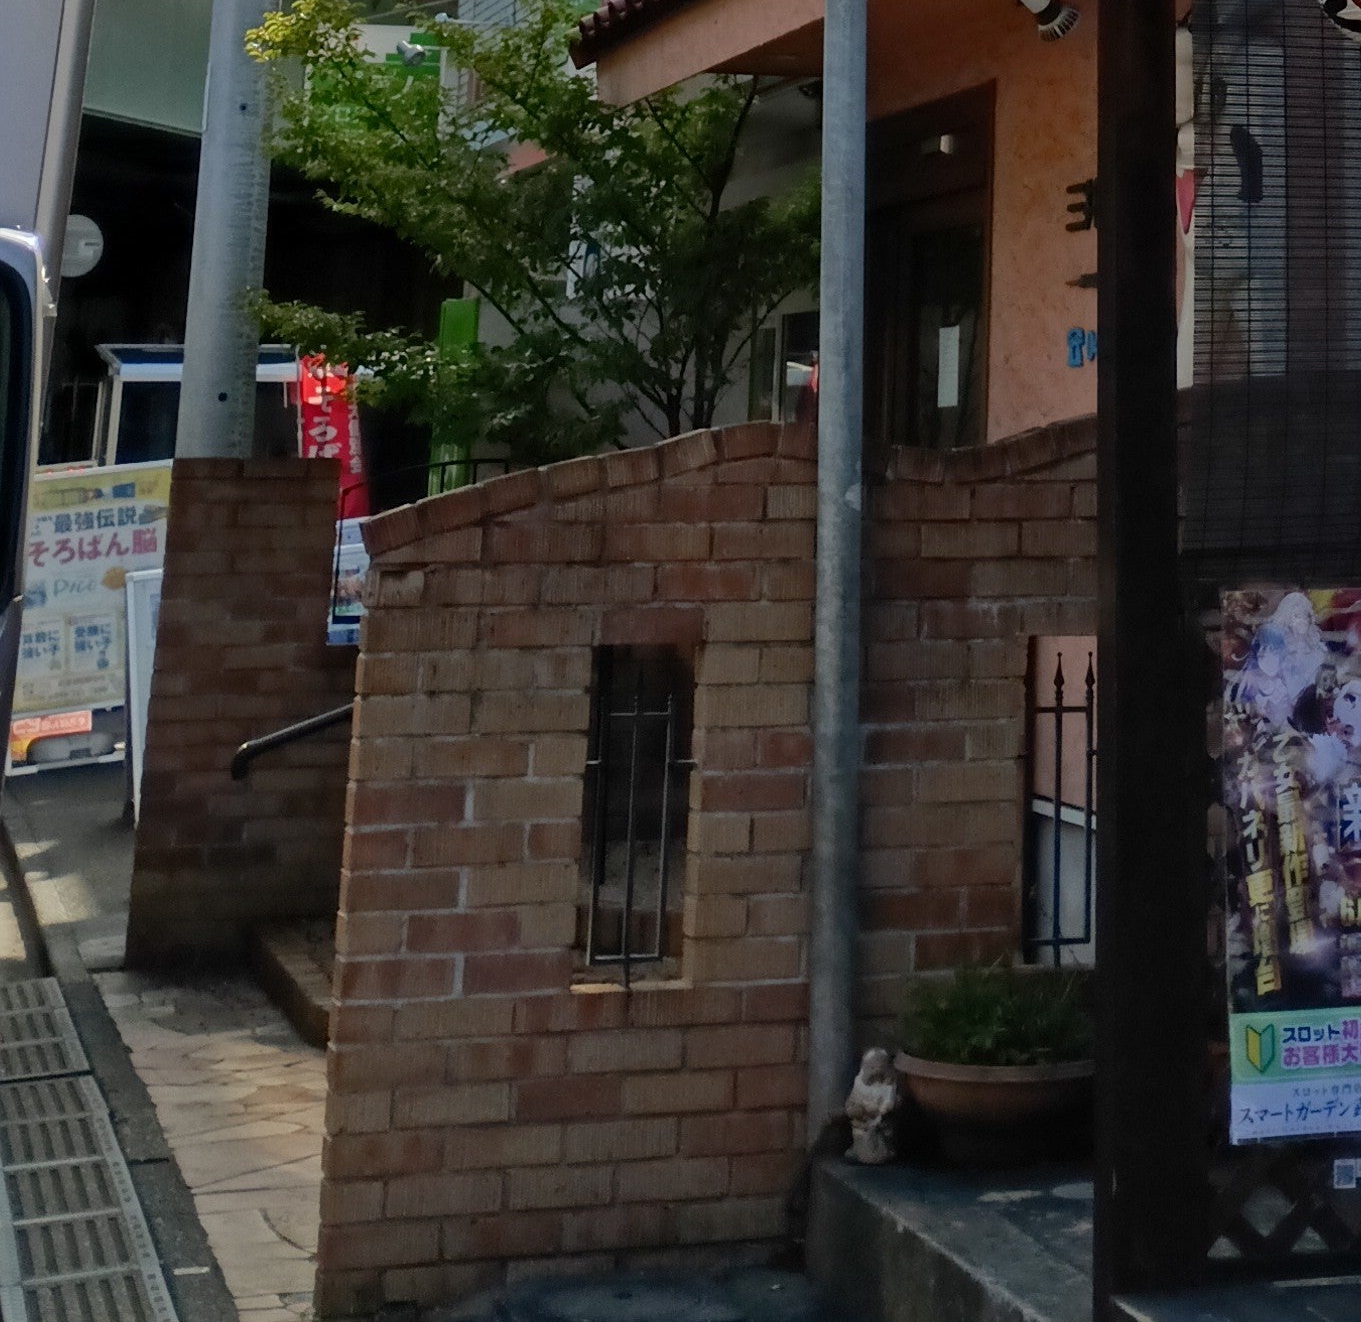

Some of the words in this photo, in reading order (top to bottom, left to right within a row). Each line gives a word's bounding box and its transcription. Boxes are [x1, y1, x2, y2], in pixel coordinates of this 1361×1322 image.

[29, 528, 158, 567] そろばん脳
